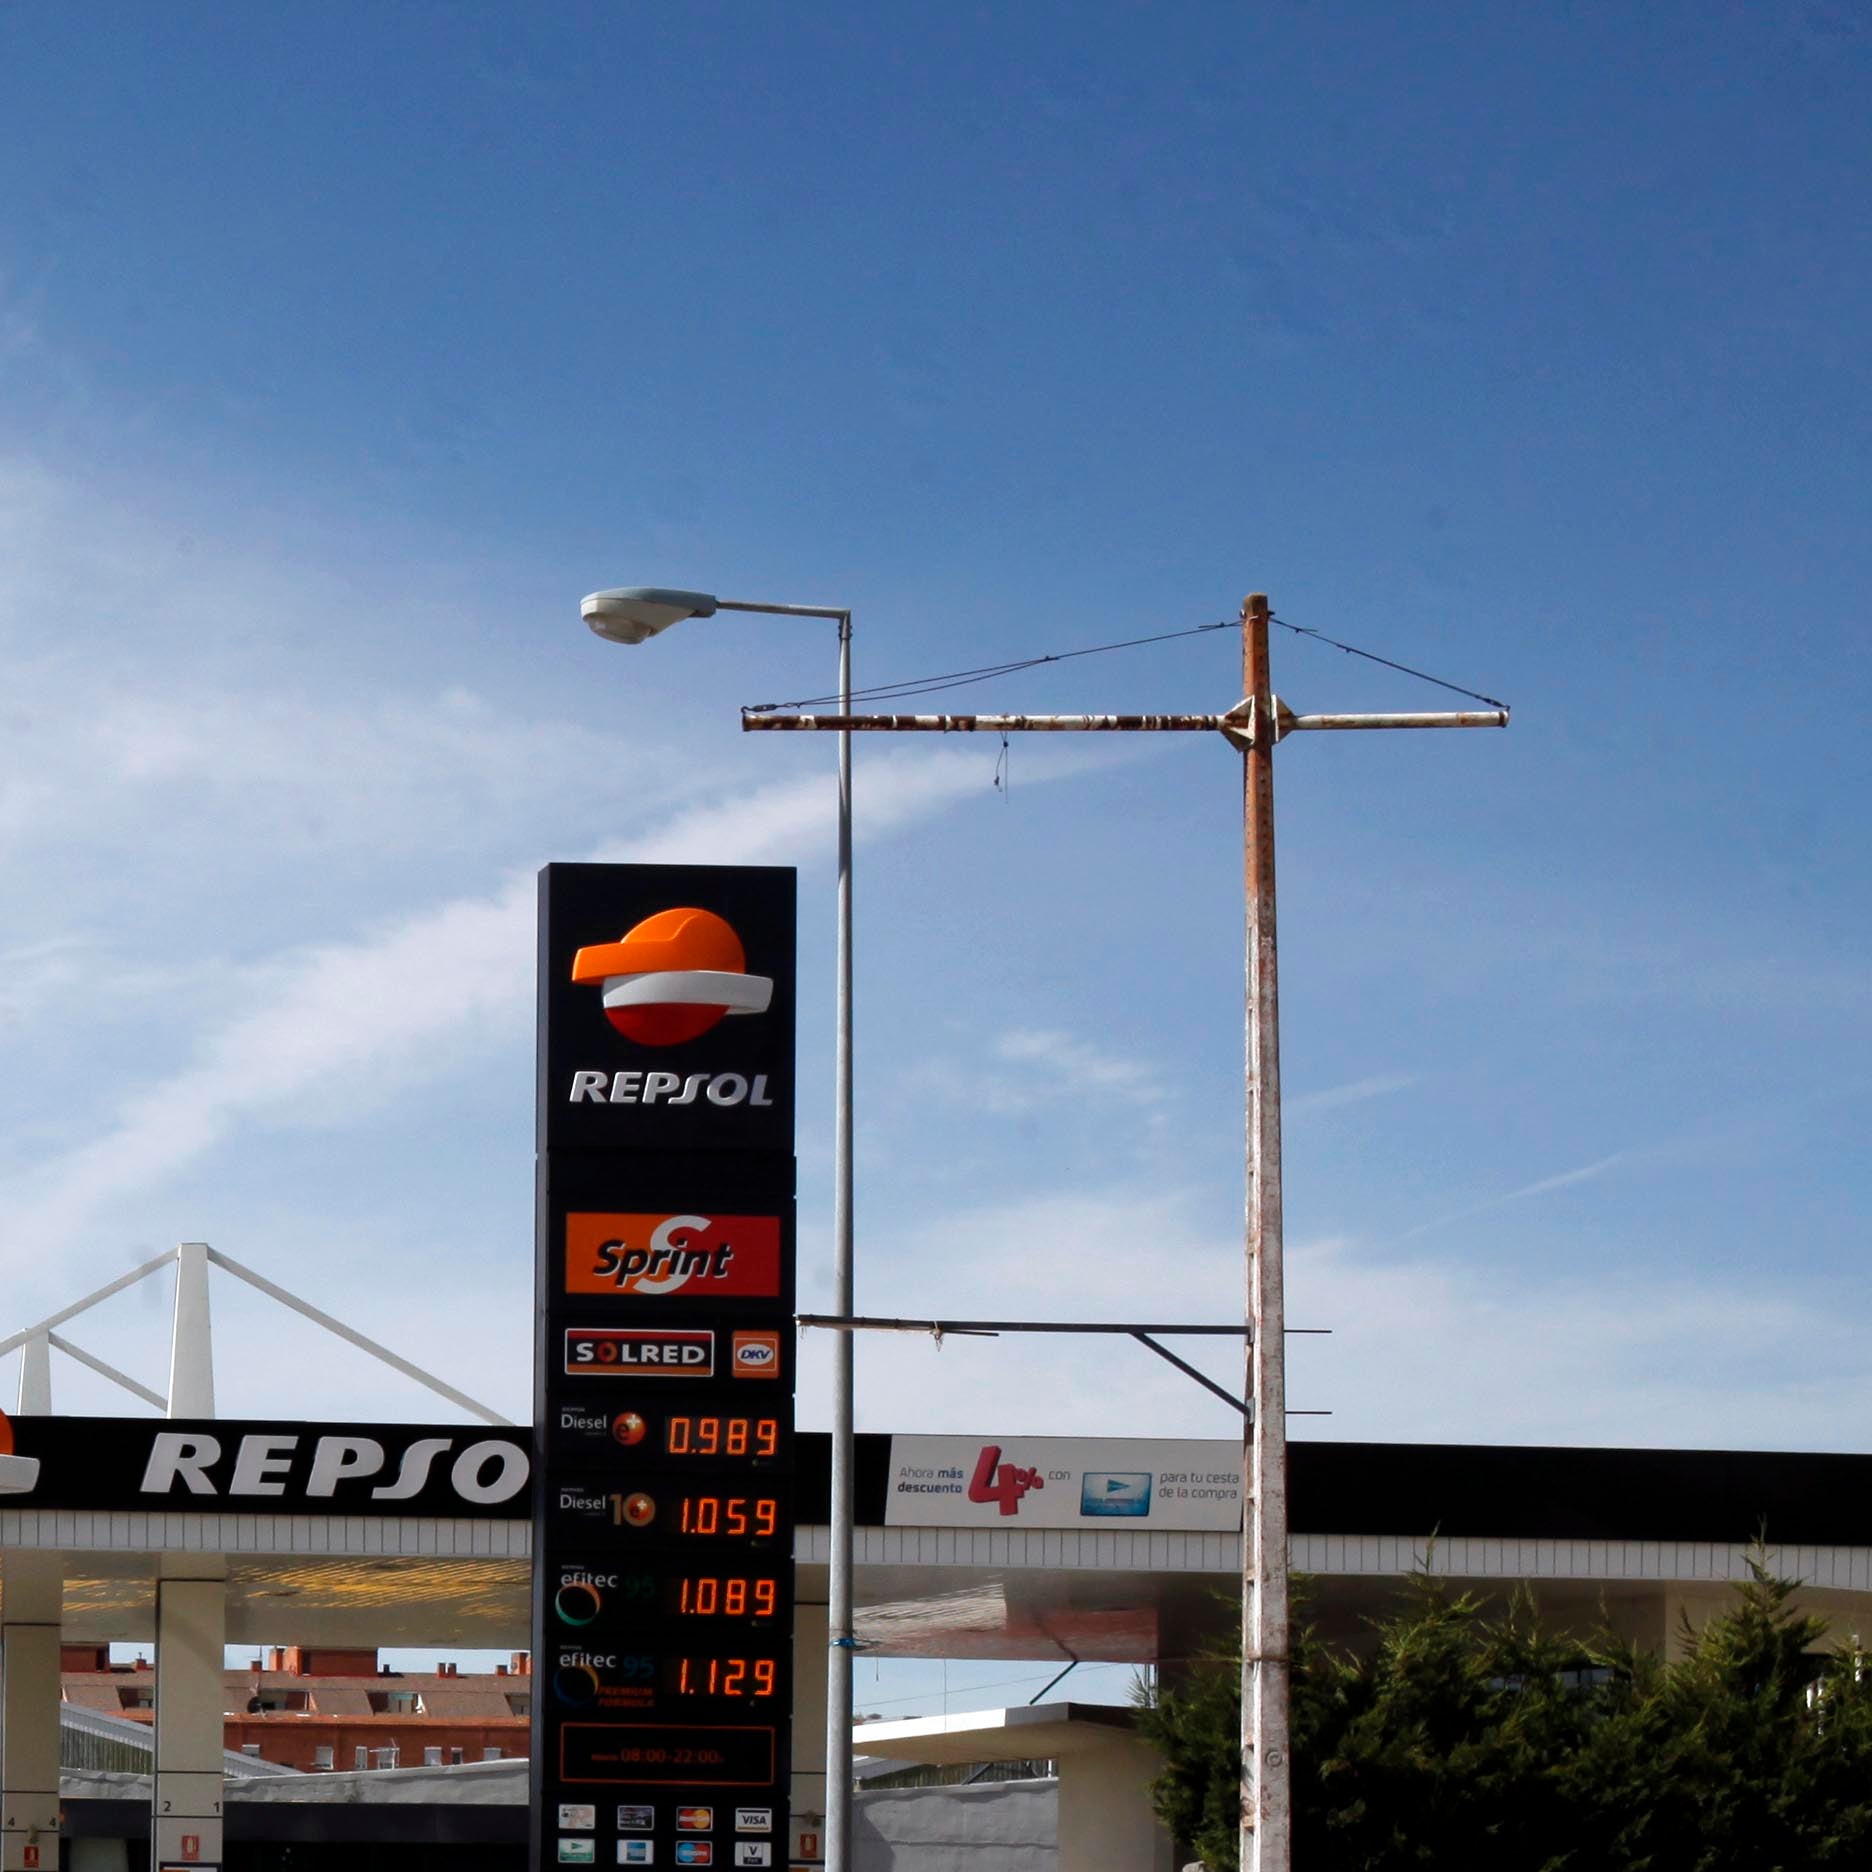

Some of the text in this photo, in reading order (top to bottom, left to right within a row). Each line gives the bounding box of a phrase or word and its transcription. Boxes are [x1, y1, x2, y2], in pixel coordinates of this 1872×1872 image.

[569, 1071, 774, 1107] REPSOL
[593, 1237, 734, 1289] Sprint
[575, 1342, 705, 1364] SOLRED
[740, 1349, 770, 1360] DKV
[560, 1413, 608, 1430] Diesel
[668, 1417, 778, 1456] 0.989
[139, 1432, 530, 1504] REPSO
[899, 1467, 964, 1480] Ahora más
[1048, 1470, 1071, 1481] con
[897, 1481, 963, 1494] descuento
[968, 1445, 1044, 1517] 4%
[1159, 1472, 1240, 1485] para tu cesta
[1158, 1486, 1238, 1502] de la compra
[559, 1493, 607, 1510] Diesel
[681, 1497, 777, 1536] 1.059
[559, 1571, 619, 1589] efitec
[680, 1577, 776, 1616] 1.089
[558, 1651, 776, 1697] efitec 95 1.129
[163, 1801, 220, 1813] 2 1
[8, 1817, 56, 1826] 4 4
[742, 1815, 767, 1825] VISA
